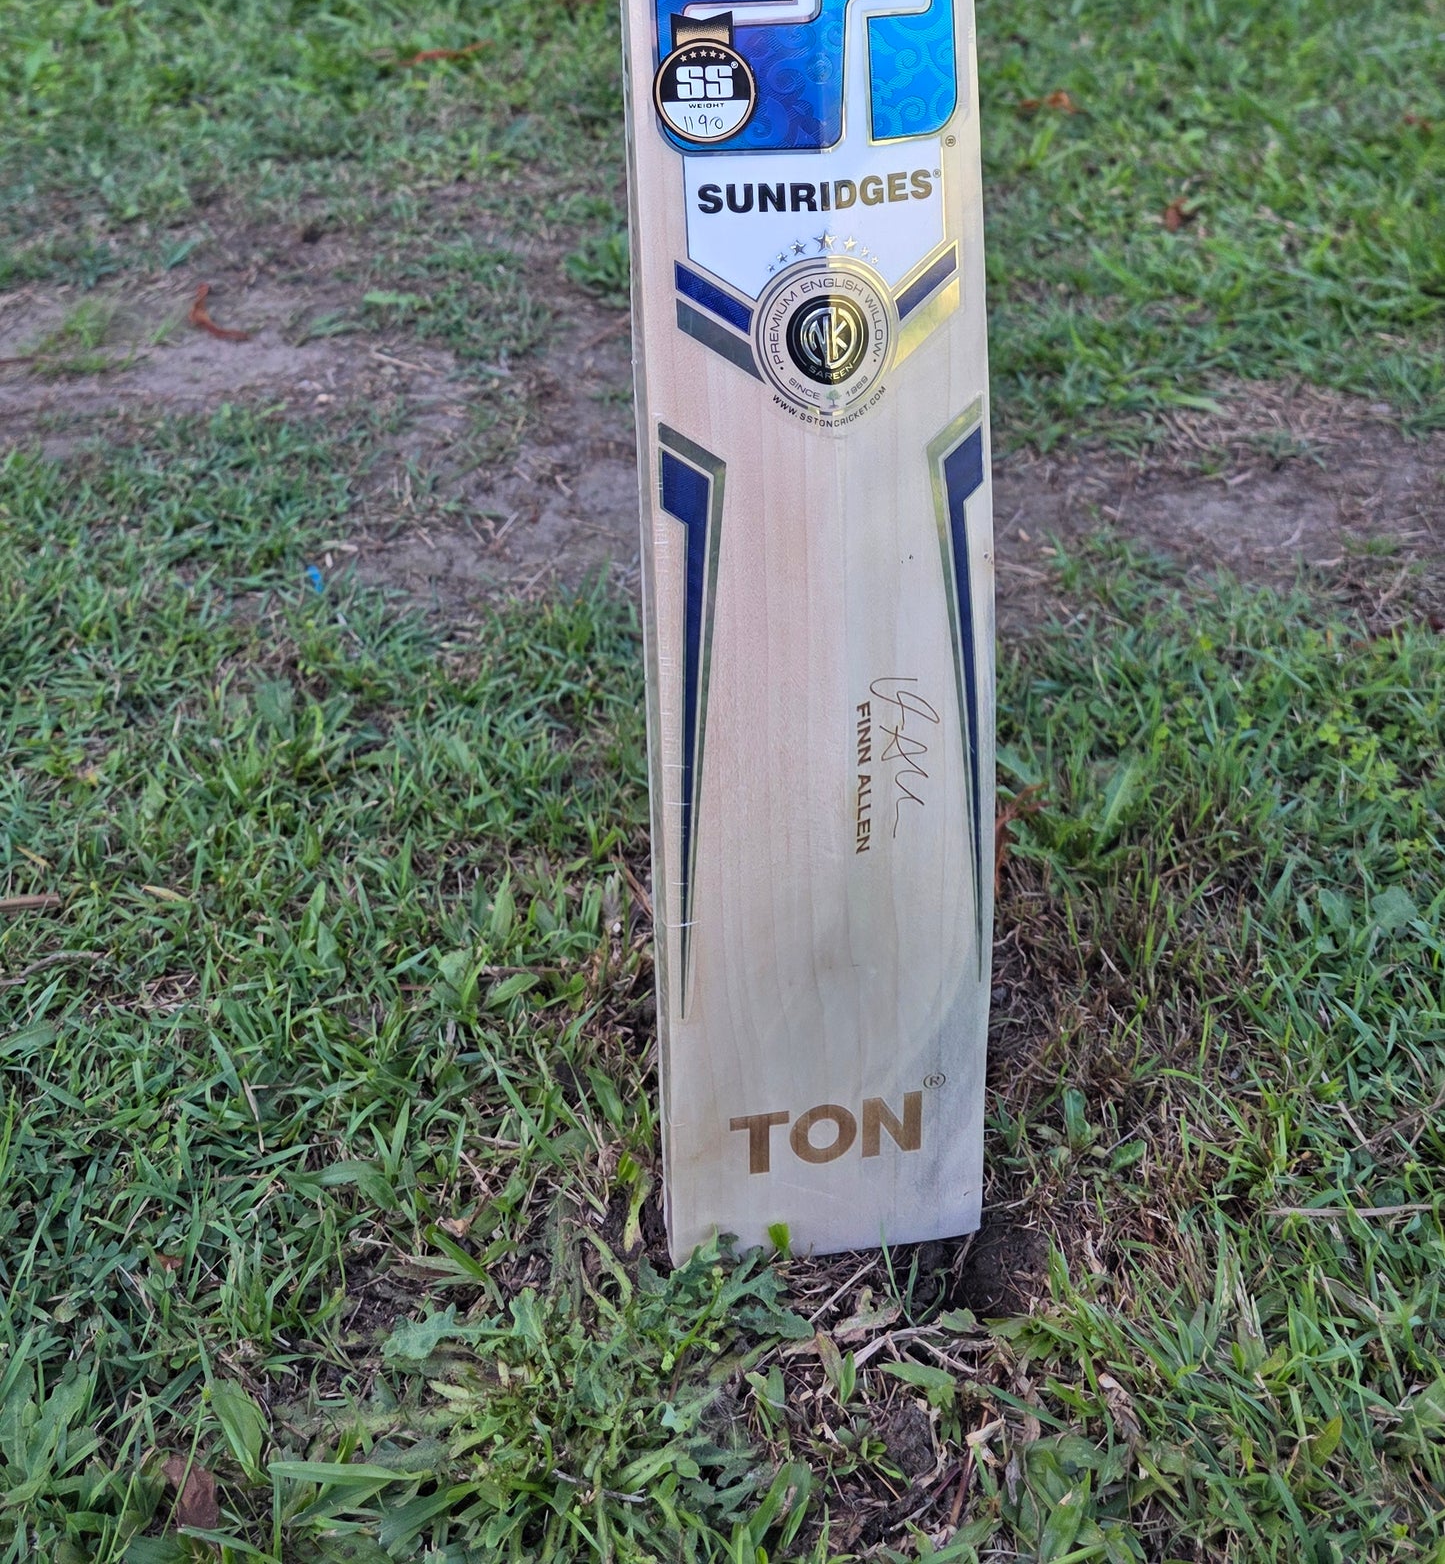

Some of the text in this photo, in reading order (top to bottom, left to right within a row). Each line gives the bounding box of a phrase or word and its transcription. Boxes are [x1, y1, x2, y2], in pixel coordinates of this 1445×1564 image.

[676, 64, 734, 100] SS
[769, 278, 884, 366] PREMIUM ENGLISH WILLOW
[788, 377, 821, 400] SINCE
[808, 363, 854, 380] SAREEN
[772, 386, 887, 428] WWW.SSTONCRICKET.COM
[856, 700, 872, 854] FINN ALLEN
[729, 1090, 923, 1175] TON
